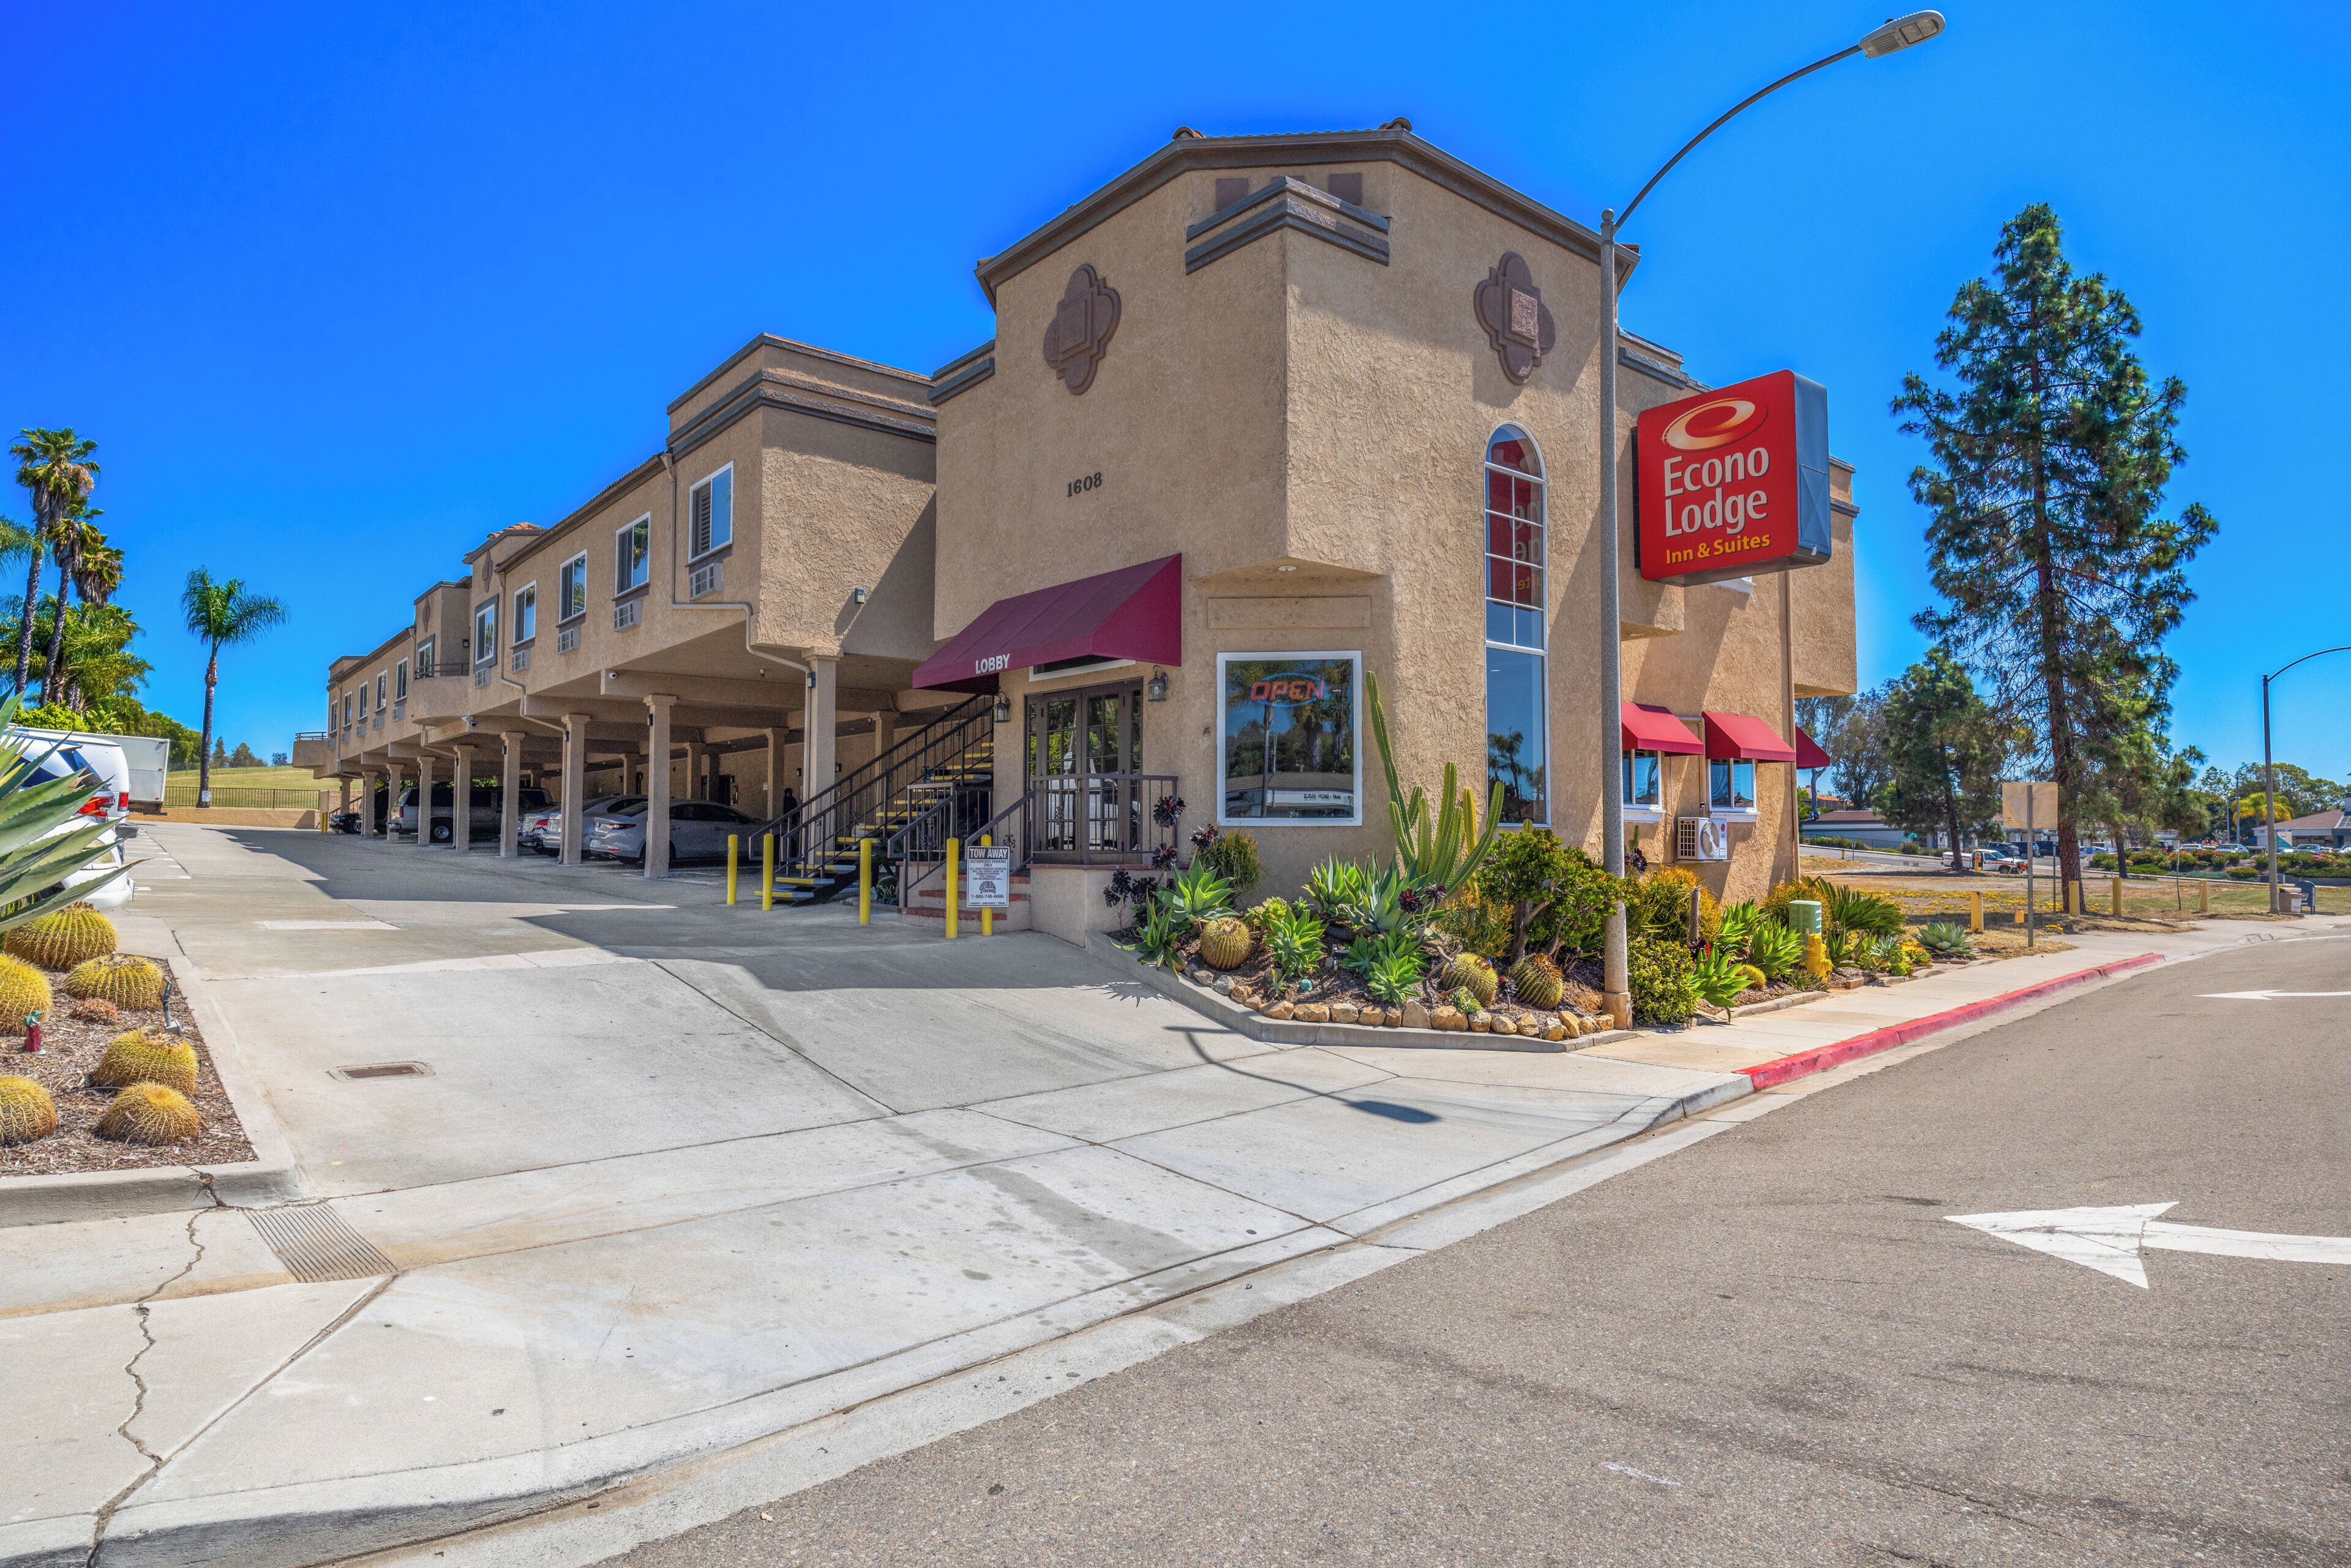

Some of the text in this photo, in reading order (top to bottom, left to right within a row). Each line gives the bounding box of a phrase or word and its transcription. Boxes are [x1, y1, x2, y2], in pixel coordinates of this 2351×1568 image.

[1067, 472, 1102, 497] 1608
[1663, 447, 1769, 497] Econo
[1665, 487, 1768, 537] Lodge
[1666, 534, 1771, 565] Inn & Suites
[975, 653, 1010, 674] LOBBY
[1250, 679, 1325, 700] OPEN
[970, 849, 1007, 858] TOW AWAY
